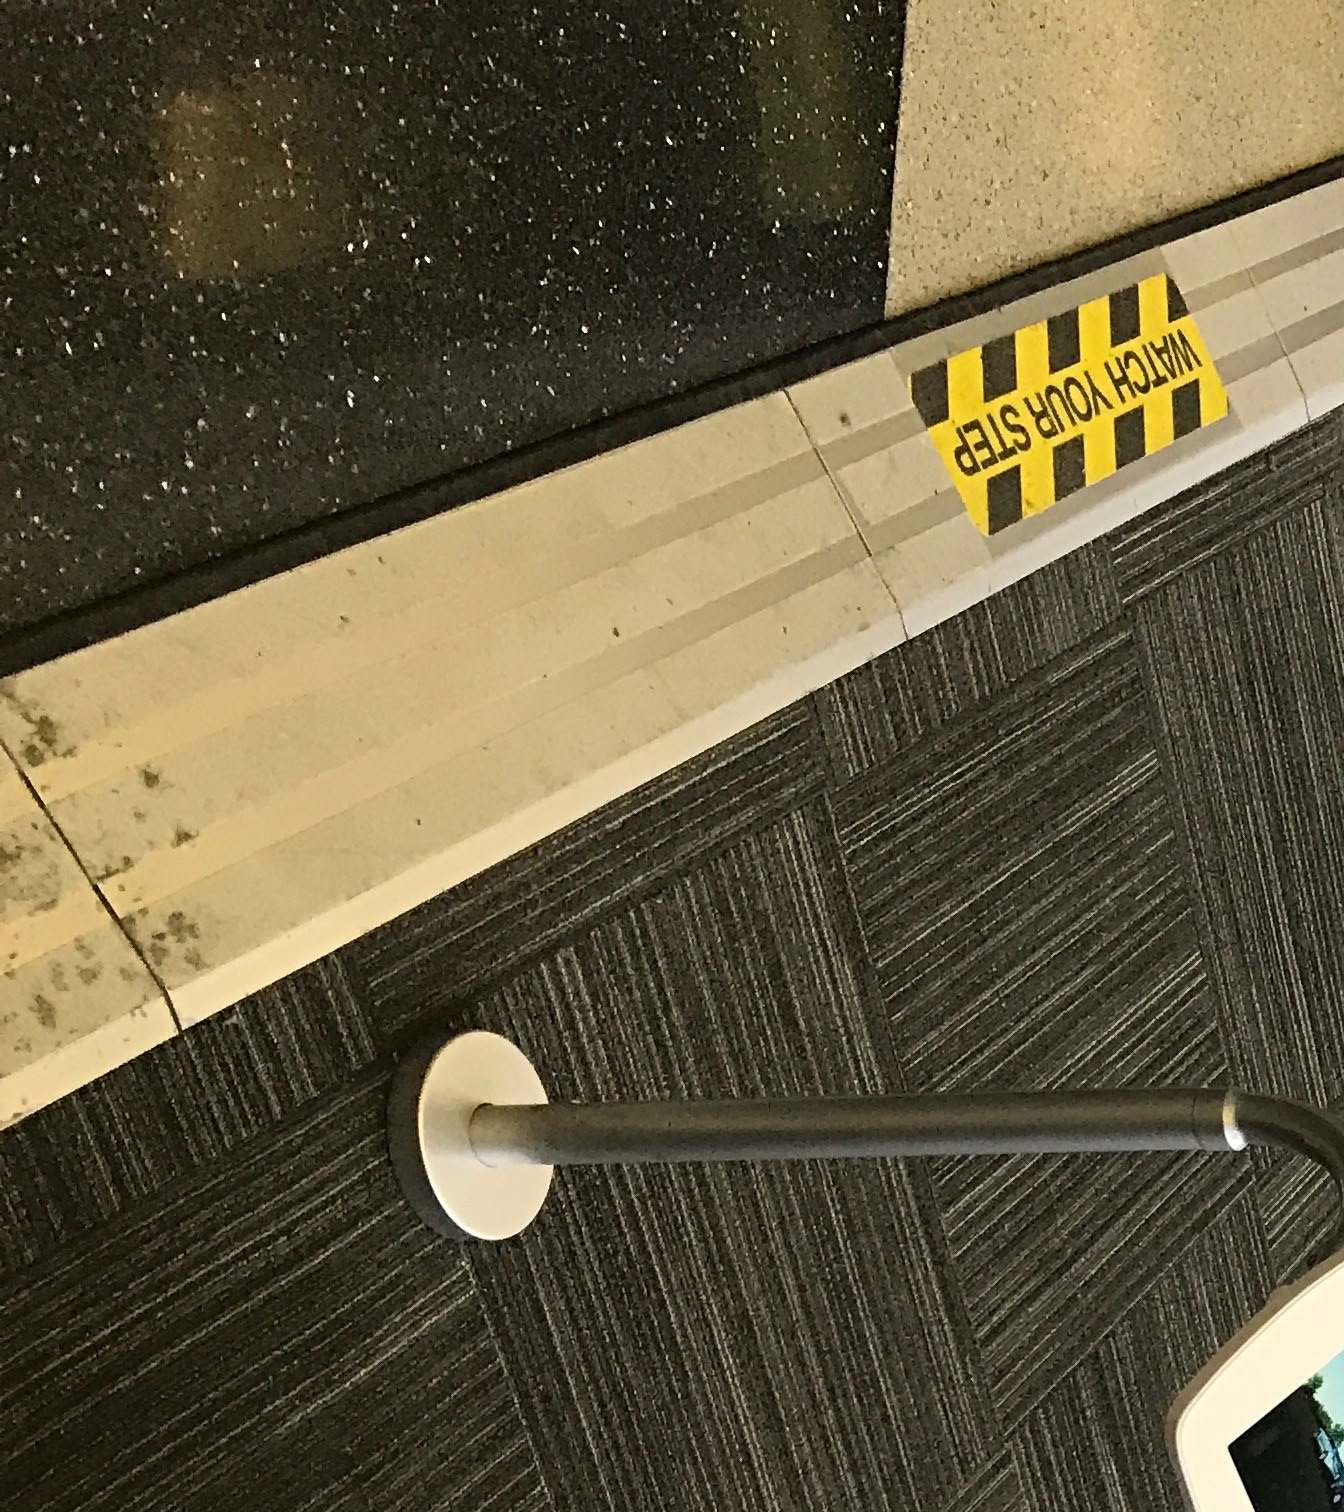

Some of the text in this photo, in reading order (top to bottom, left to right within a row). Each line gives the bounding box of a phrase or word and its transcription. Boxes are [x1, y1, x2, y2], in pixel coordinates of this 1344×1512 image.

[954, 329, 1203, 477] WATCH YOUR STEP
